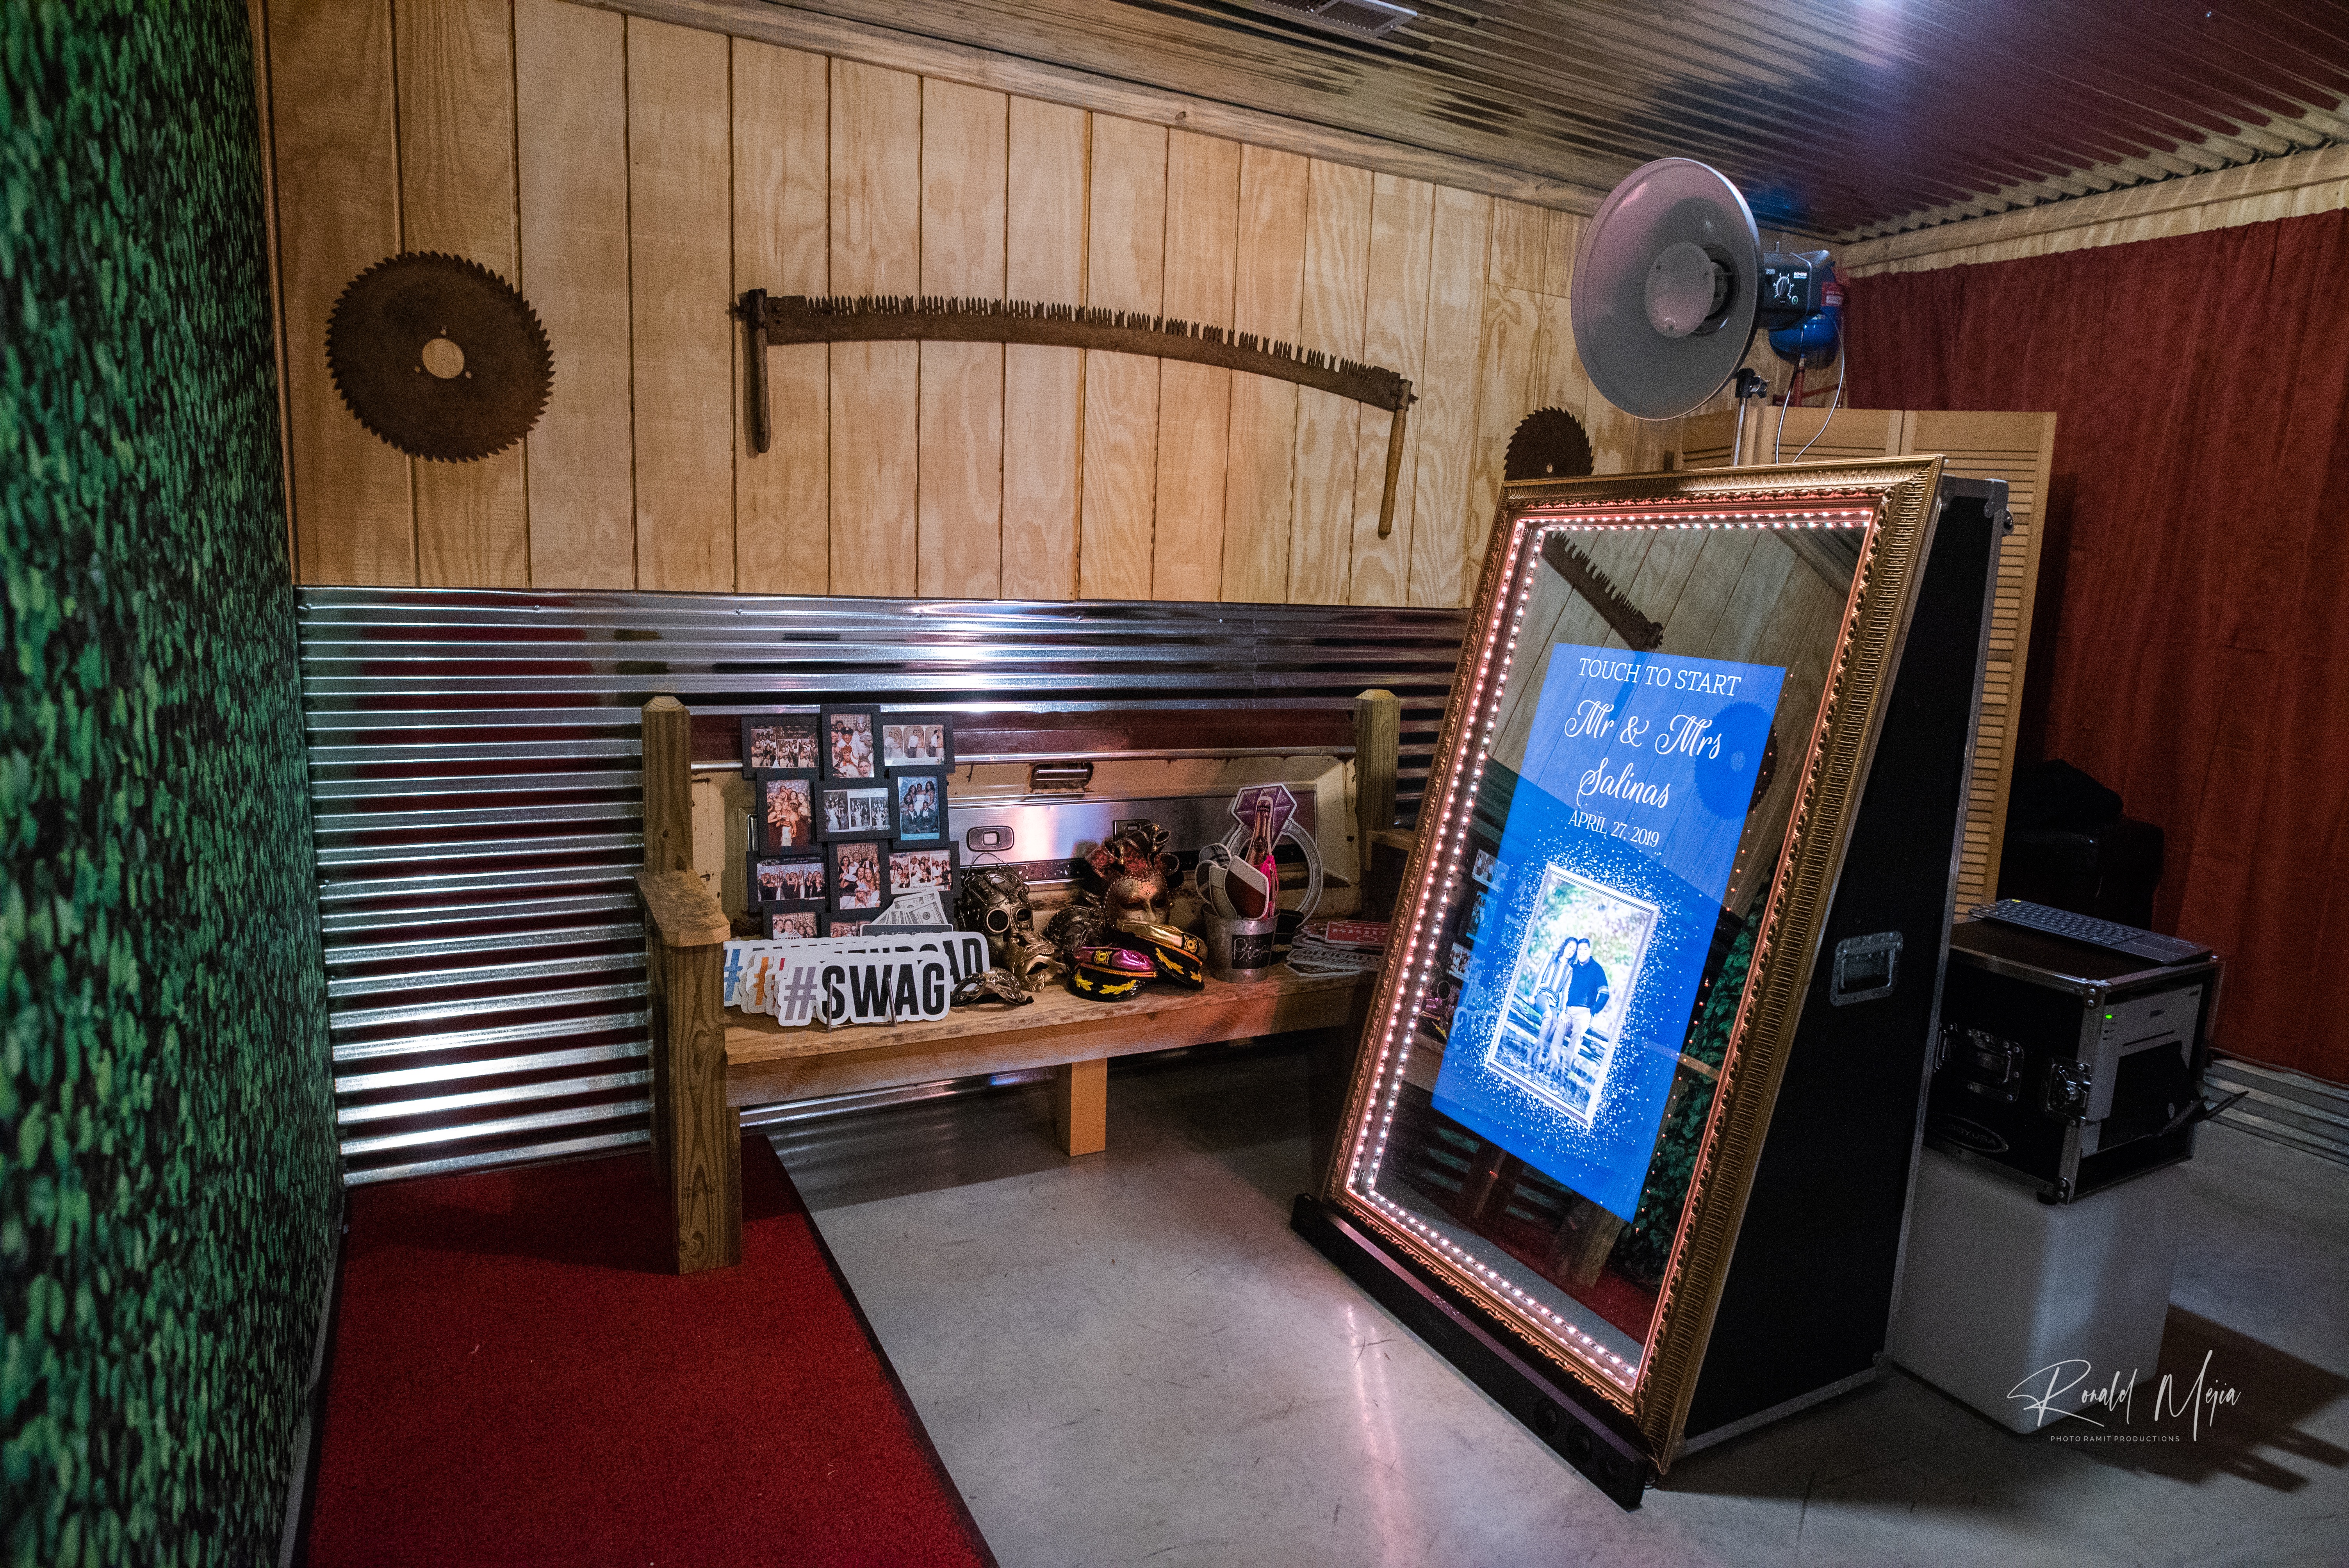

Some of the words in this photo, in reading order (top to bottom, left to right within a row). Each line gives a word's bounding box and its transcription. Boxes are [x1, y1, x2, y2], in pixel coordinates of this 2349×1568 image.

[1579, 657, 1641, 683] TOUCH
[1645, 666, 1672, 687] TO
[1675, 670, 1742, 697] START
[1564, 699, 1615, 739] Mr
[1619, 716, 1650, 747] &
[1654, 714, 1722, 760] Mrs
[1576, 757, 1671, 809] Salinas
[1568, 810, 1608, 834] APRIL
[1610, 821, 1628, 841] 27,
[1630, 827, 1660, 847] 2019
[784, 962, 945, 1021] #SWAG
